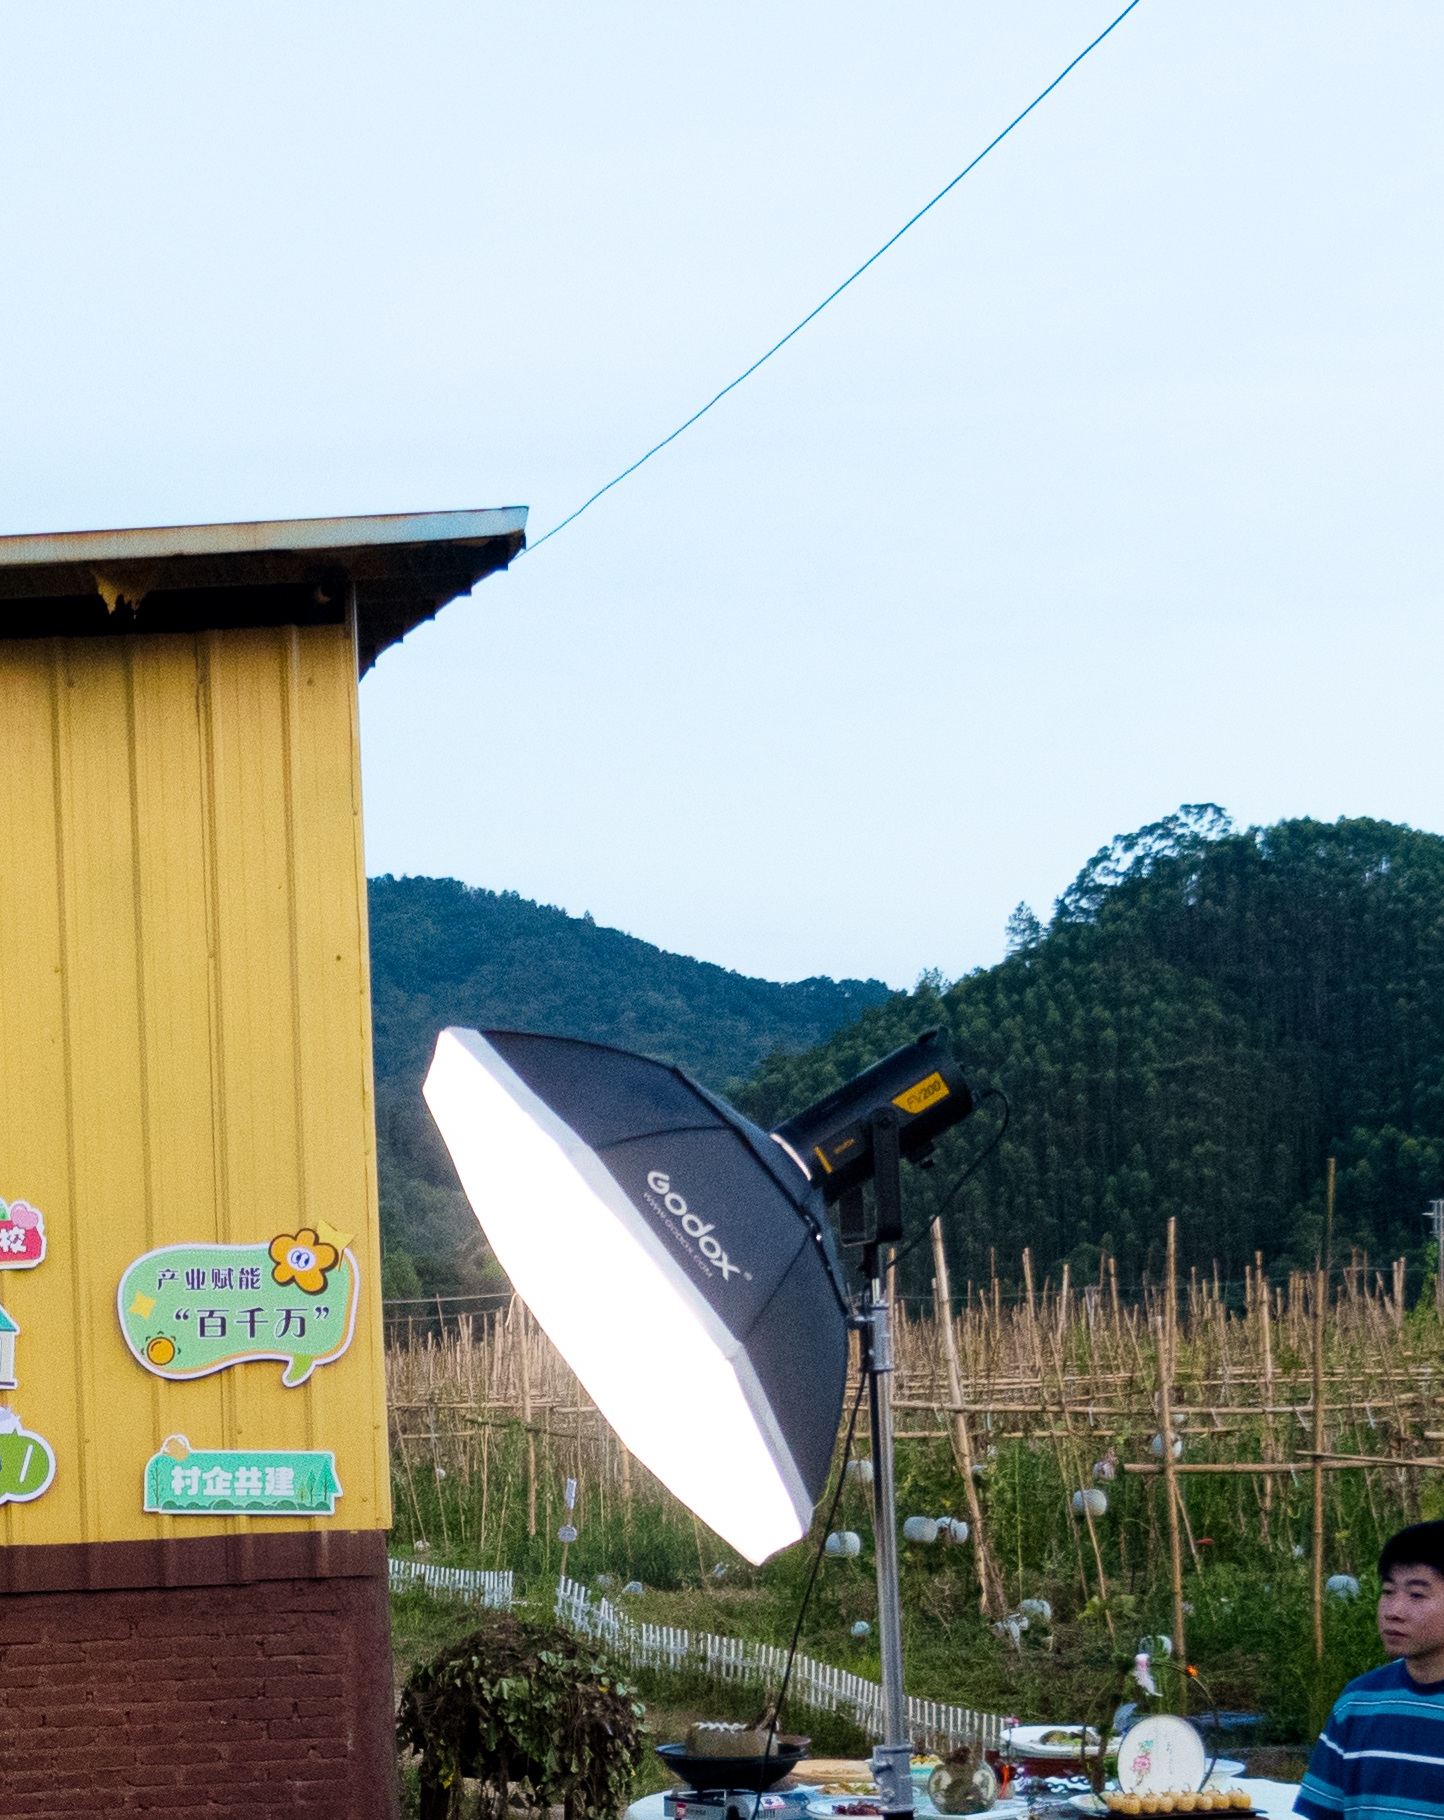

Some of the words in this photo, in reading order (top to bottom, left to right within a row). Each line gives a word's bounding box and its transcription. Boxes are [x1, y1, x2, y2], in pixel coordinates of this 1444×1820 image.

[157, 1267, 261, 1291] 产业赋能
[174, 1306, 330, 1338] “百千万”
[171, 1466, 295, 1496] 村企共建
